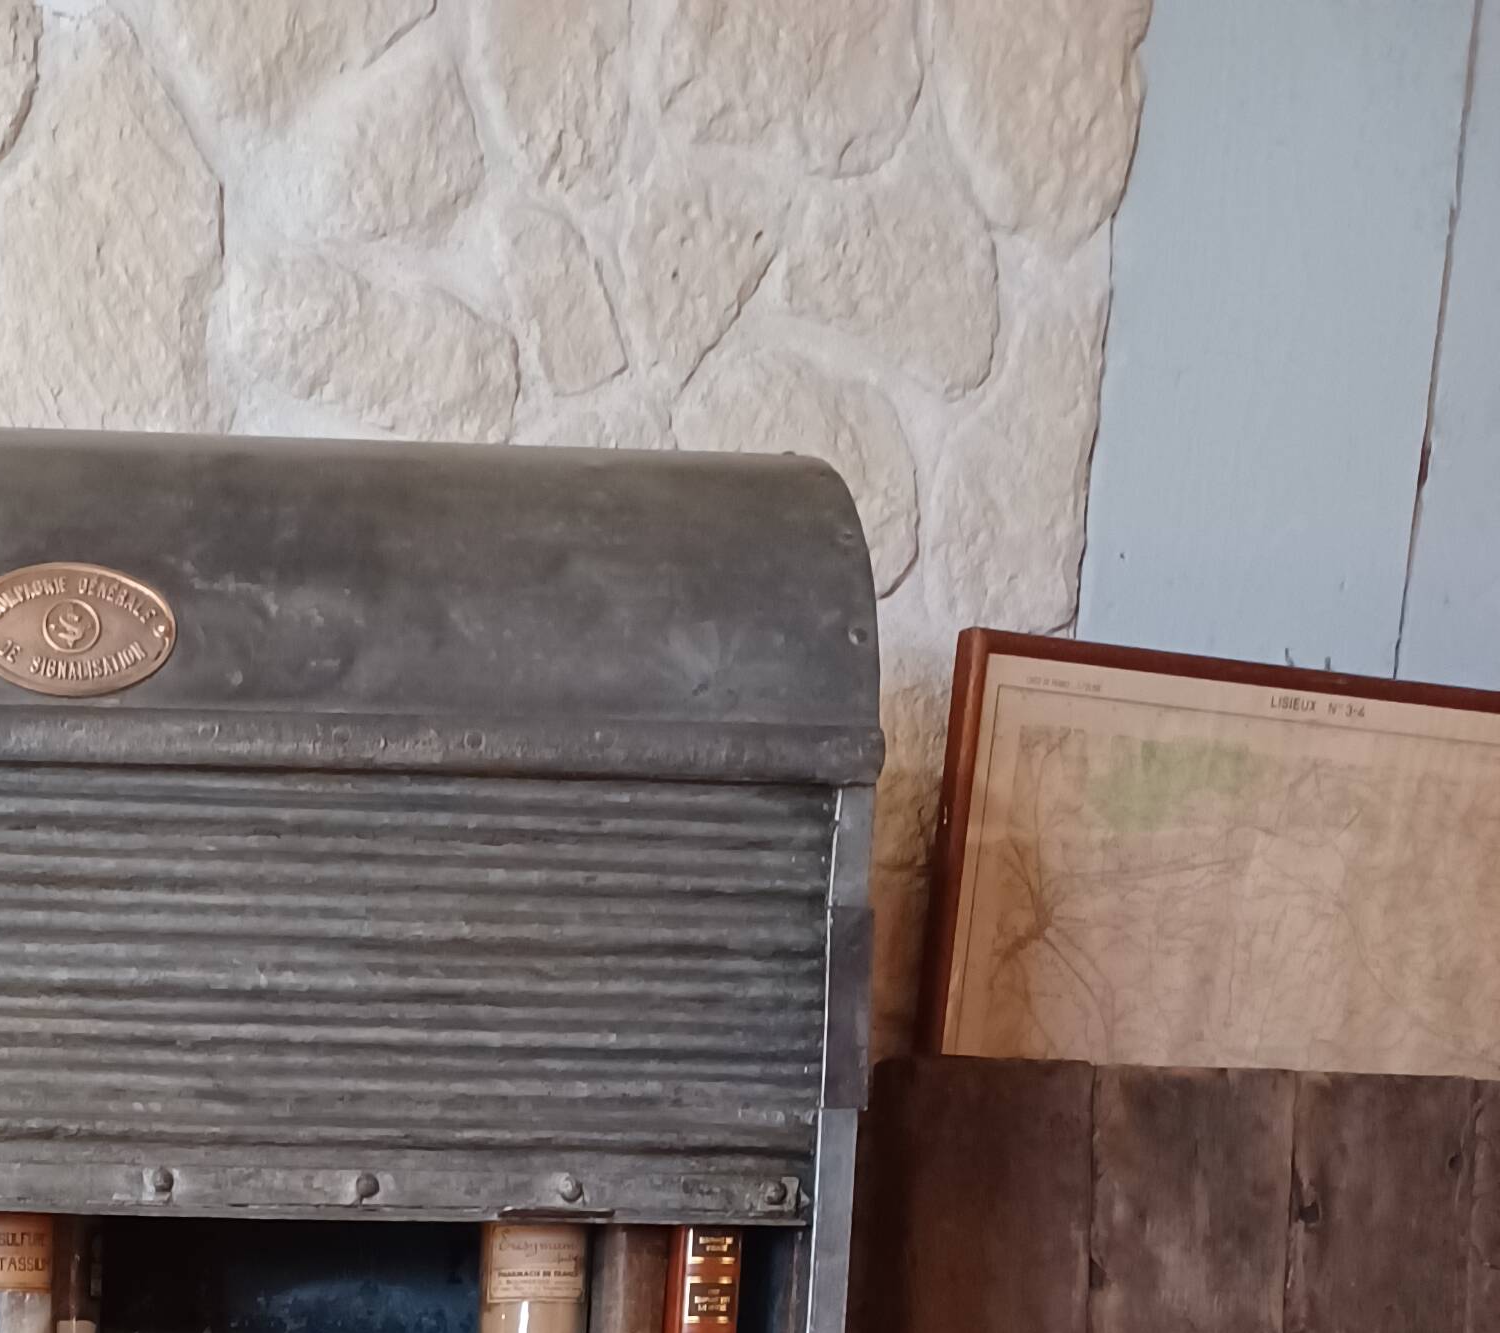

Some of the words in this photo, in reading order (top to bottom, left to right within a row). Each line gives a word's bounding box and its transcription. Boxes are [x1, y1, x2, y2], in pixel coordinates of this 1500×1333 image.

[78, 576, 157, 625] GÉNÉRALE
[30, 641, 148, 682] SIGNALISATION
[1270, 696, 1317, 712] LISIEUX
